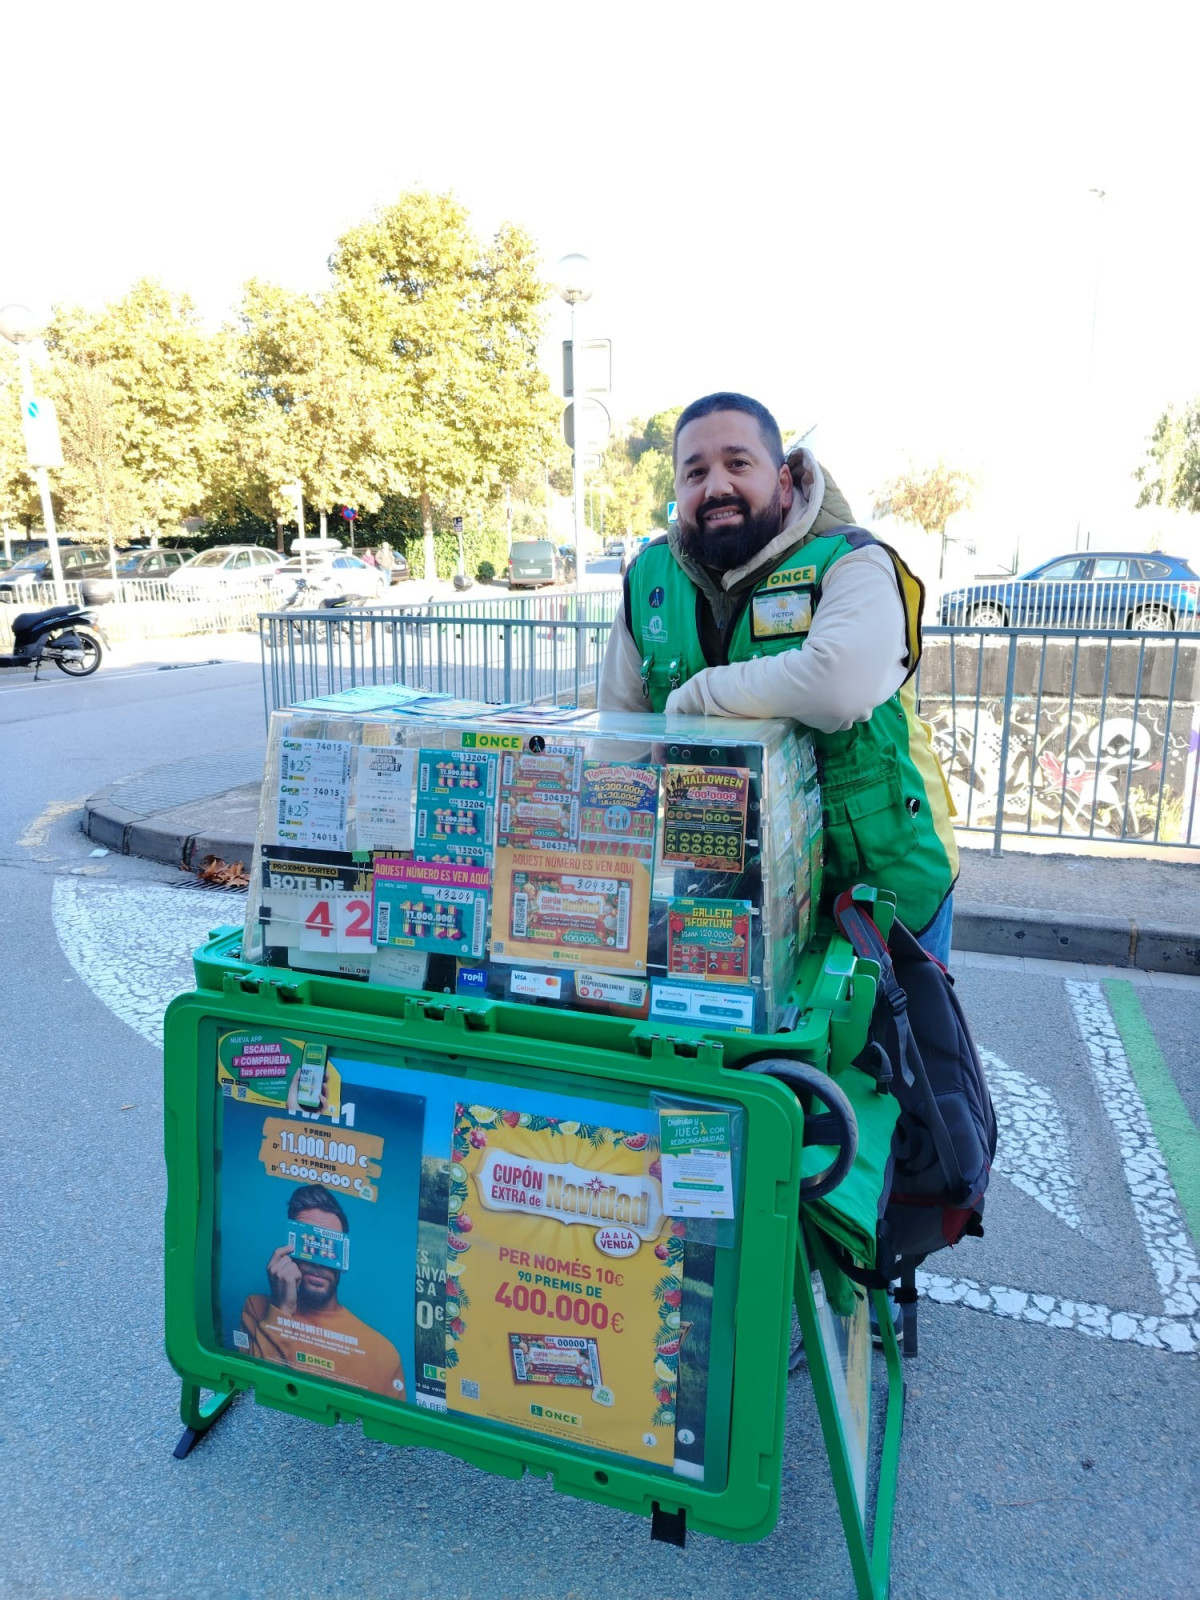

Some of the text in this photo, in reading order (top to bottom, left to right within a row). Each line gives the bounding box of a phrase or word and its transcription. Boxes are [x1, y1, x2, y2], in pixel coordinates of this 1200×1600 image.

[770, 569, 811, 585] ONCE
[316, 742, 342, 752] 74015
[478, 736, 519, 748] ONCE
[547, 746, 573, 755] 30432
[463, 753, 487, 762] 13204
[683, 774, 744, 789] HALLOWEEN
[313, 787, 340, 797] 74015
[543, 794, 570, 803] 30432
[460, 800, 485, 809] 13204
[311, 832, 338, 842] 74015
[458, 846, 483, 855] 13204
[541, 841, 568, 850] 30432
[512, 854, 635, 874] AQUEST NÚMERO ES VEN AQUÍ
[307, 866, 337, 875] SORTEO
[374, 863, 490, 885] AQUEST NÚMERO ES VEN AQUÍ
[269, 873, 317, 890] BOTE
[320, 878, 345, 891] DE
[577, 878, 616, 892] 30432
[436, 888, 472, 902] 13204
[692, 907, 733, 918] GALLETA
[691, 918, 733, 929] FORTUNA
[560, 952, 580, 960] ONCE
[514, 973, 527, 981] VISA
[243, 1044, 281, 1055] ESCANEA
[240, 1055, 292, 1066] COMPRUEBA
[241, 1067, 287, 1078] tus premios
[667, 1118, 693, 1127] Disfruta
[309, 1128, 332, 1138] PREMI
[709, 1126, 725, 1135] CON
[670, 1135, 725, 1146] RESPONSABILIDAD
[309, 1160, 337, 1172] PREMIS
[492, 1163, 544, 1191] CUPÓN
[491, 1184, 541, 1207] EXTRA de
[545, 1173, 649, 1227] Navidad
[600, 1231, 611, 1240] JA
[622, 1232, 633, 1240] LA
[600, 1239, 635, 1250] VENDA
[499, 1246, 625, 1287] PER NOMÉS 10€
[427, 1281, 437, 1297] A
[517, 1270, 603, 1299] 90 PREMIS DE
[494, 1281, 625, 1334] 400.000€
[557, 1338, 585, 1348] 00000
[307, 1356, 332, 1369] ONCE
[545, 1410, 578, 1425] ONCE
